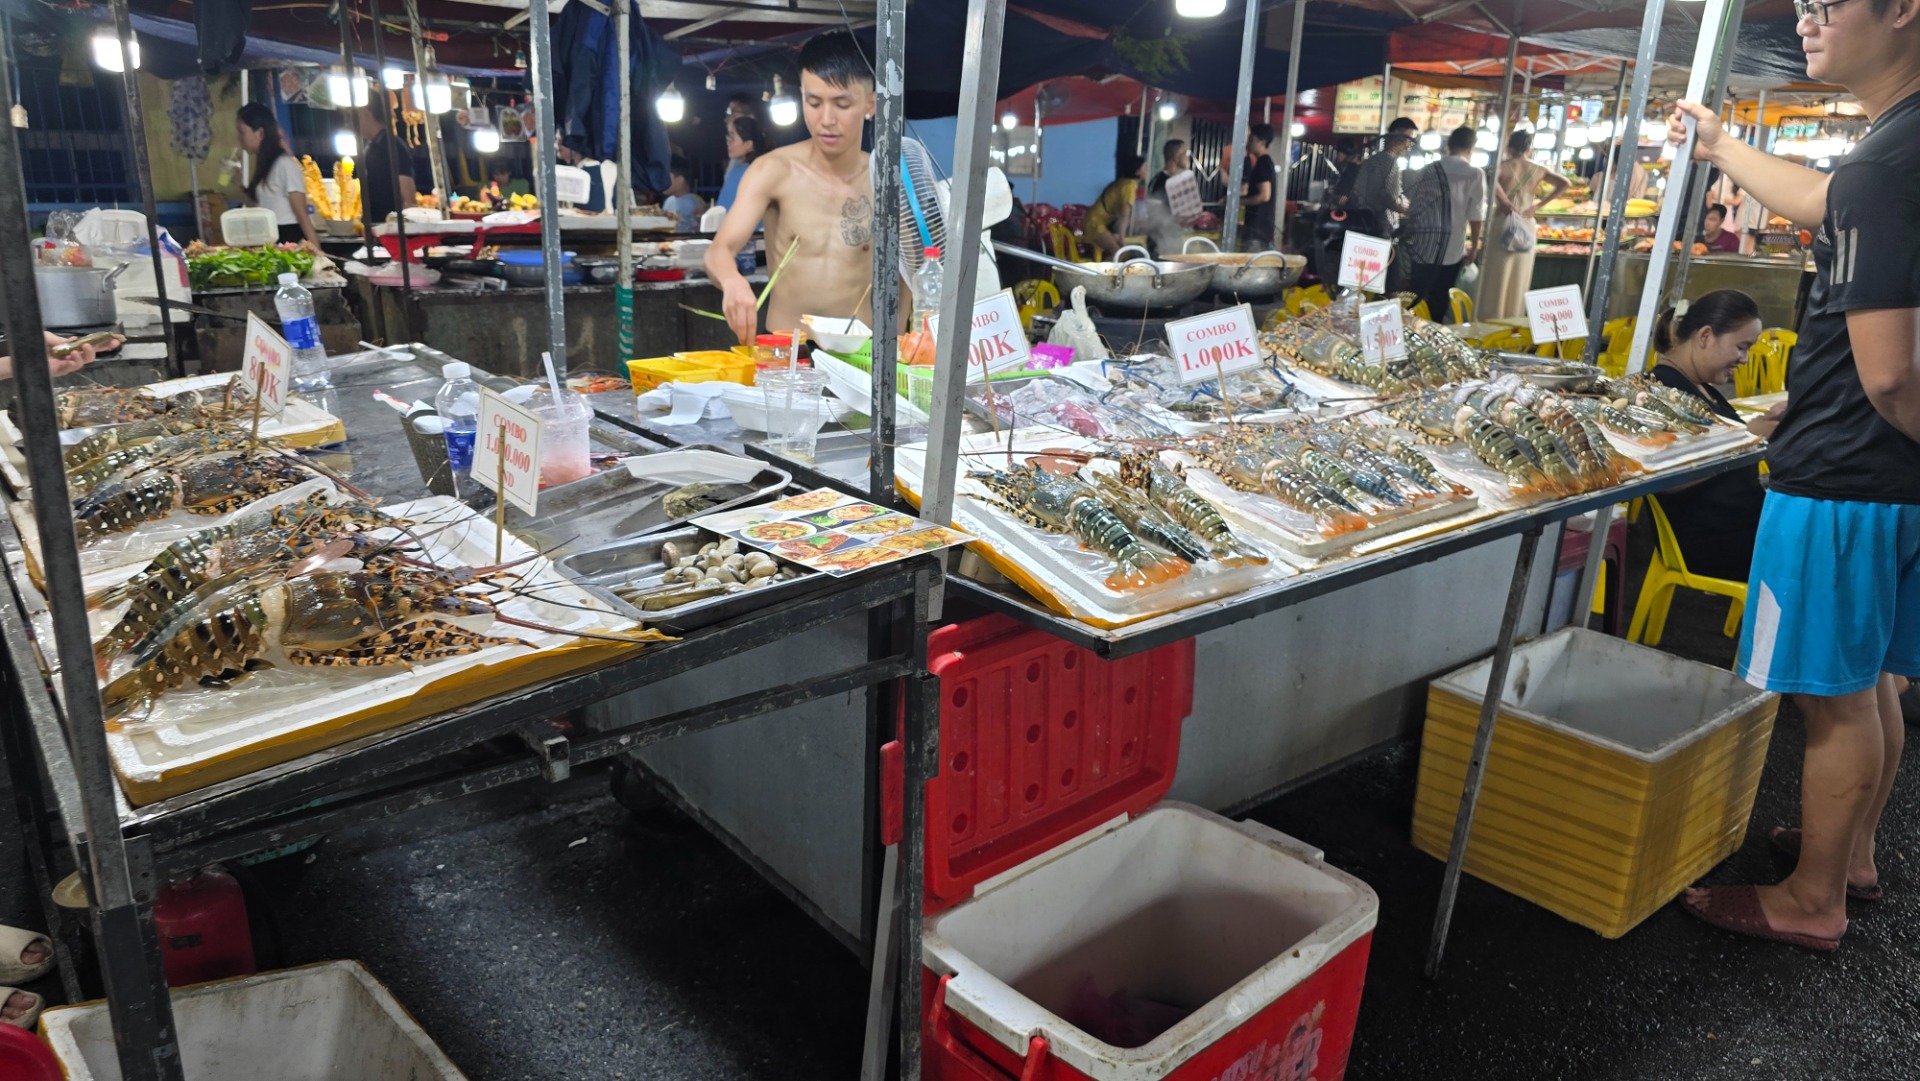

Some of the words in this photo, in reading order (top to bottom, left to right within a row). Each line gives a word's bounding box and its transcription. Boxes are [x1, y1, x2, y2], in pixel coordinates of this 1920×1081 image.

[1538, 297, 1569, 309] COMBO
[971, 310, 1000, 329] MBO
[1540, 309, 1573, 324] 500000
[1186, 321, 1237, 343] COMBO
[967, 330, 1017, 367] 00K
[1181, 337, 1256, 371] 1.000K
[493, 414, 526, 443] COMBO
[486, 433, 530, 473] 1.00.000
